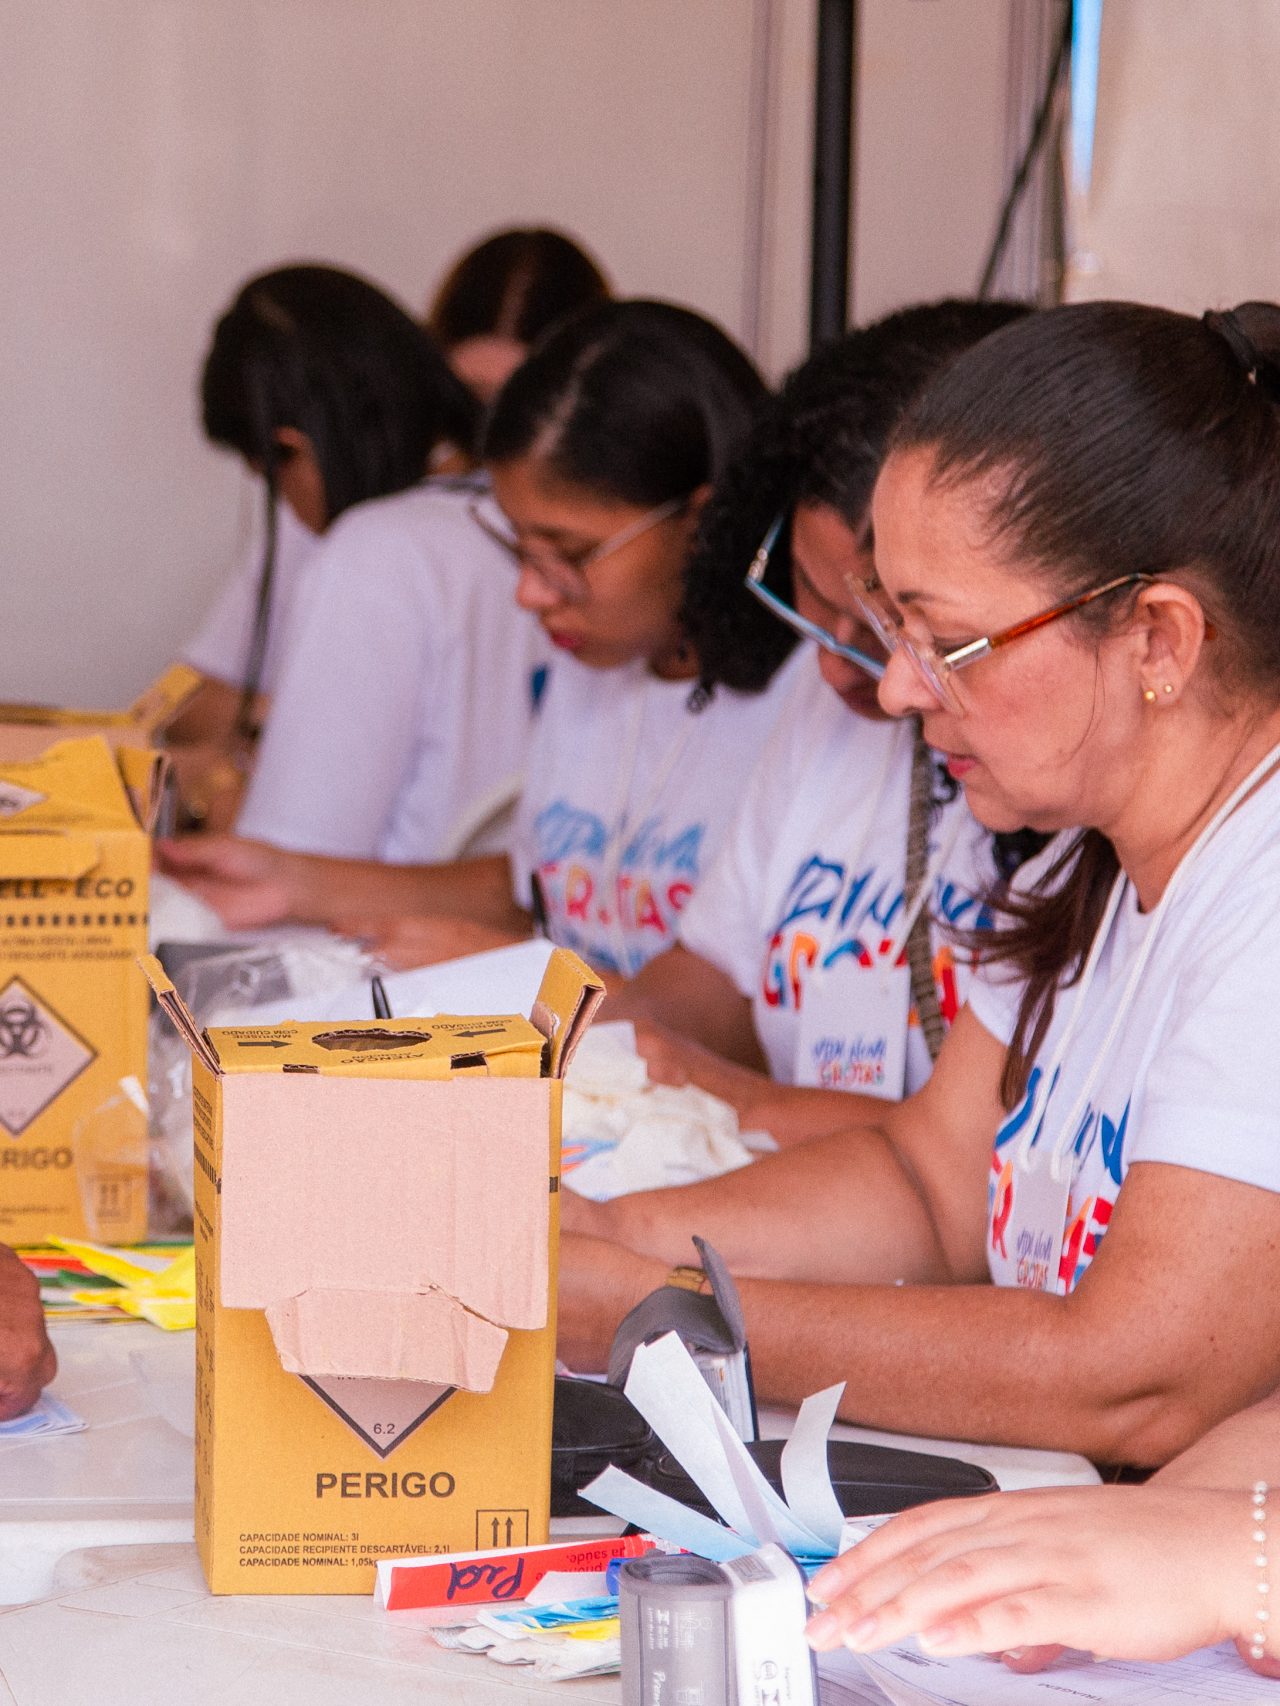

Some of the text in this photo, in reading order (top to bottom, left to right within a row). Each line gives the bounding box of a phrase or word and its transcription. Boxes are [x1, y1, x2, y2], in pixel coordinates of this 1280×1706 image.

[73, 878, 135, 900] ECO
[373, 1423, 396, 1435] 6.2
[315, 1471, 456, 1499] PERIGO
[239, 1533, 300, 1542] CAPACIDADE
[302, 1533, 349, 1542] NOMINAL:
[239, 1545, 300, 1554] CAPACIDADE
[302, 1544, 358, 1554] RECIPIENTE
[360, 1543, 432, 1554] DESCARTÁVEL:
[239, 1558, 300, 1567] CAPACIDADE
[302, 1557, 349, 1567] NOMINAL:
[566, 1549, 608, 1565] saúde.
